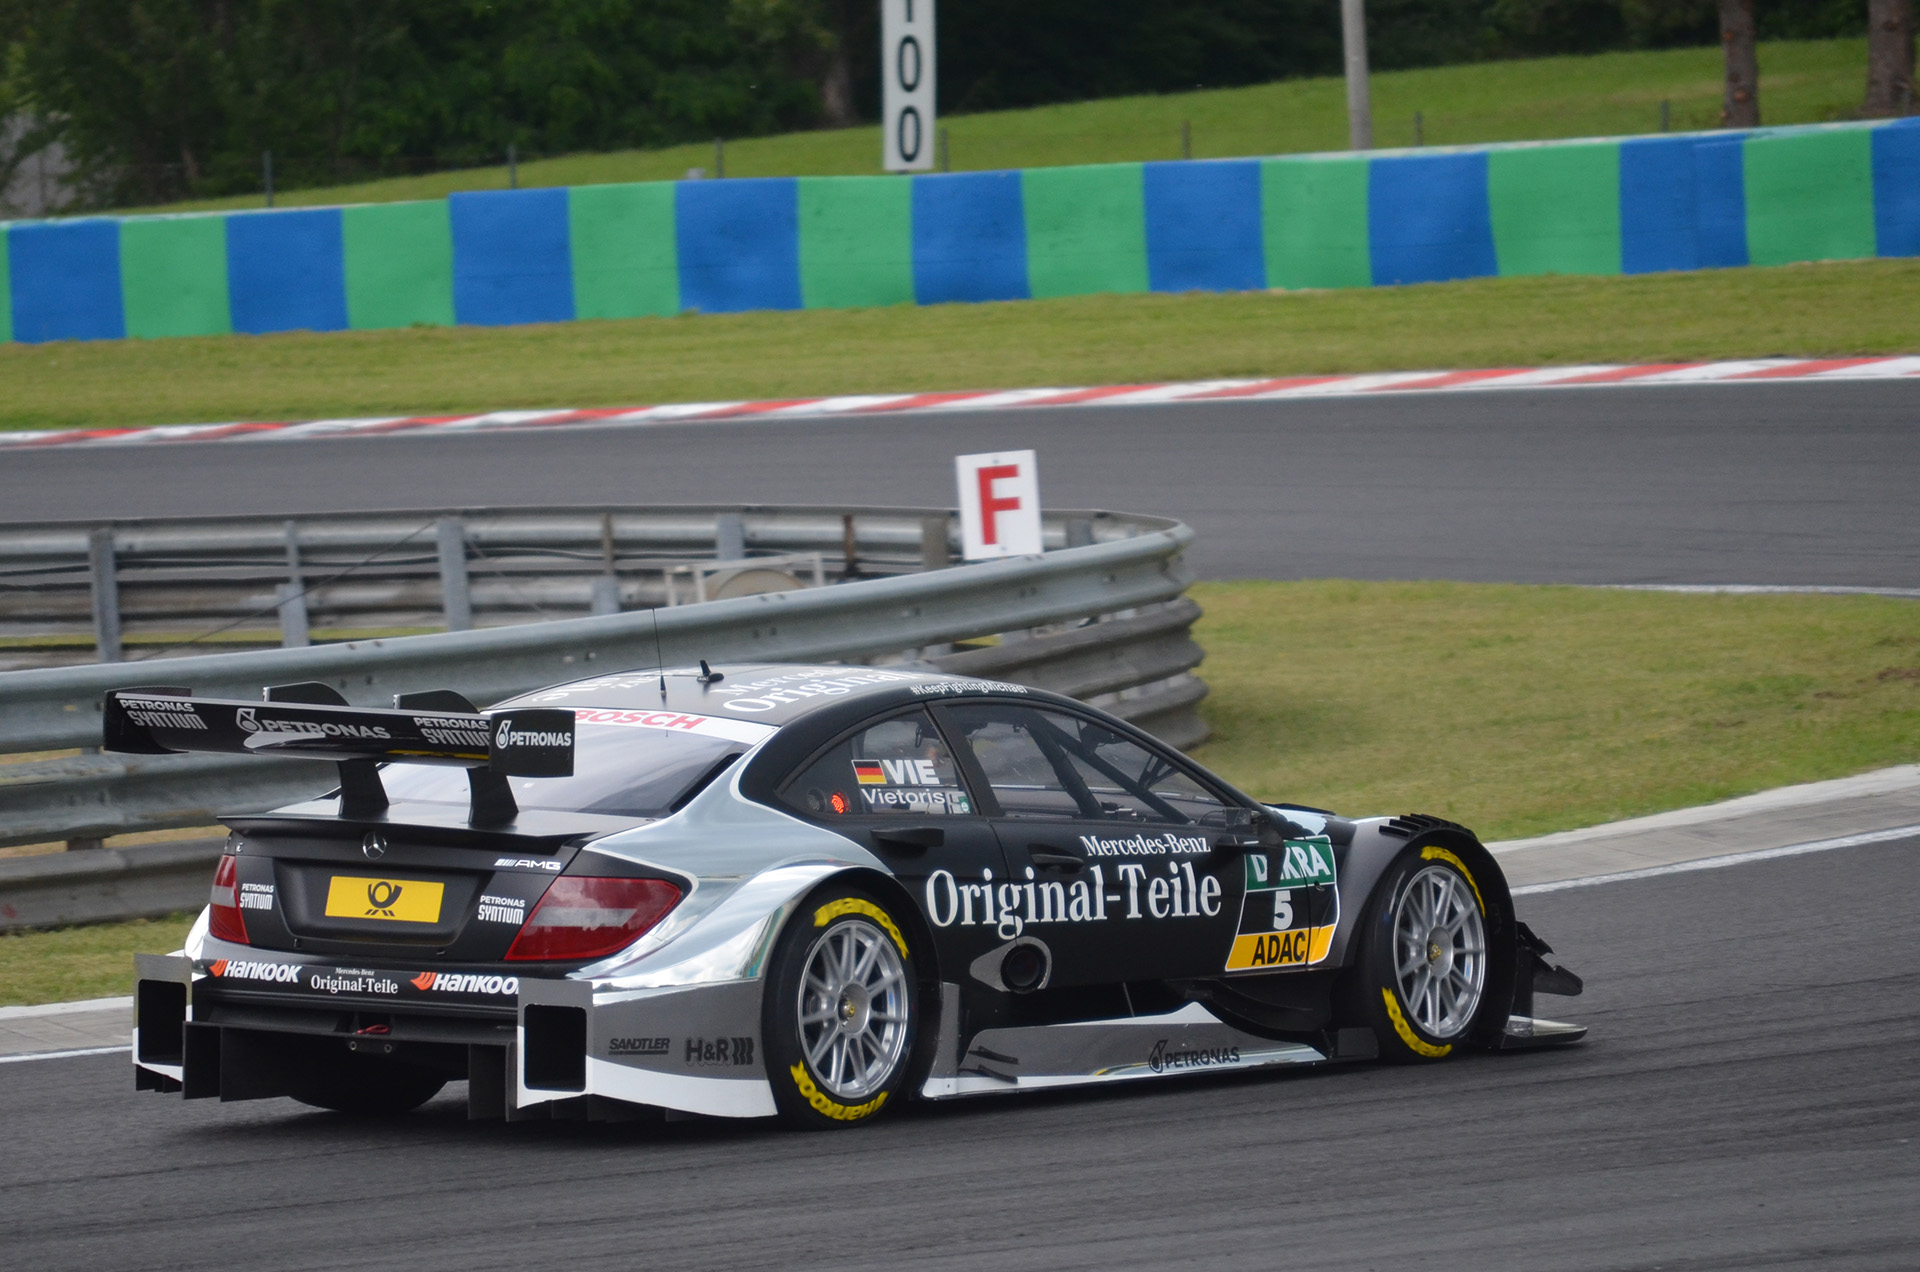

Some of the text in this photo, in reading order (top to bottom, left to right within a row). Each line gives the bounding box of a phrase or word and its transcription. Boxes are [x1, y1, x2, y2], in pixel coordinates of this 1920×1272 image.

[976, 464, 1022, 546] F
[119, 699, 195, 713] PETRONAS
[126, 710, 208, 730] SYNTIUM
[262, 719, 391, 739] PETRONAS
[413, 717, 489, 730] PETRONAS
[510, 731, 572, 747] PETRONAS
[882, 759, 941, 785] VIE
[861, 788, 946, 805] Vietoris
[1079, 833, 1212, 857] Mercedes-Benz
[512, 859, 562, 871] AMG
[1250, 844, 1332, 882] DKRA
[241, 883, 274, 893] PETRONAS
[240, 892, 273, 910] SYNTIUM
[480, 895, 526, 908] PETRONAS
[926, 861, 1223, 941] Original-Teile
[1273, 890, 1294, 930] 5
[478, 904, 524, 925] SYNTIUM
[1251, 931, 1306, 966] ADAC
[311, 974, 399, 994] Original-Teile
[609, 1037, 671, 1051] SANDTLER
[685, 1038, 729, 1063] H&R
[1164, 1046, 1241, 1069] PETRONAS
